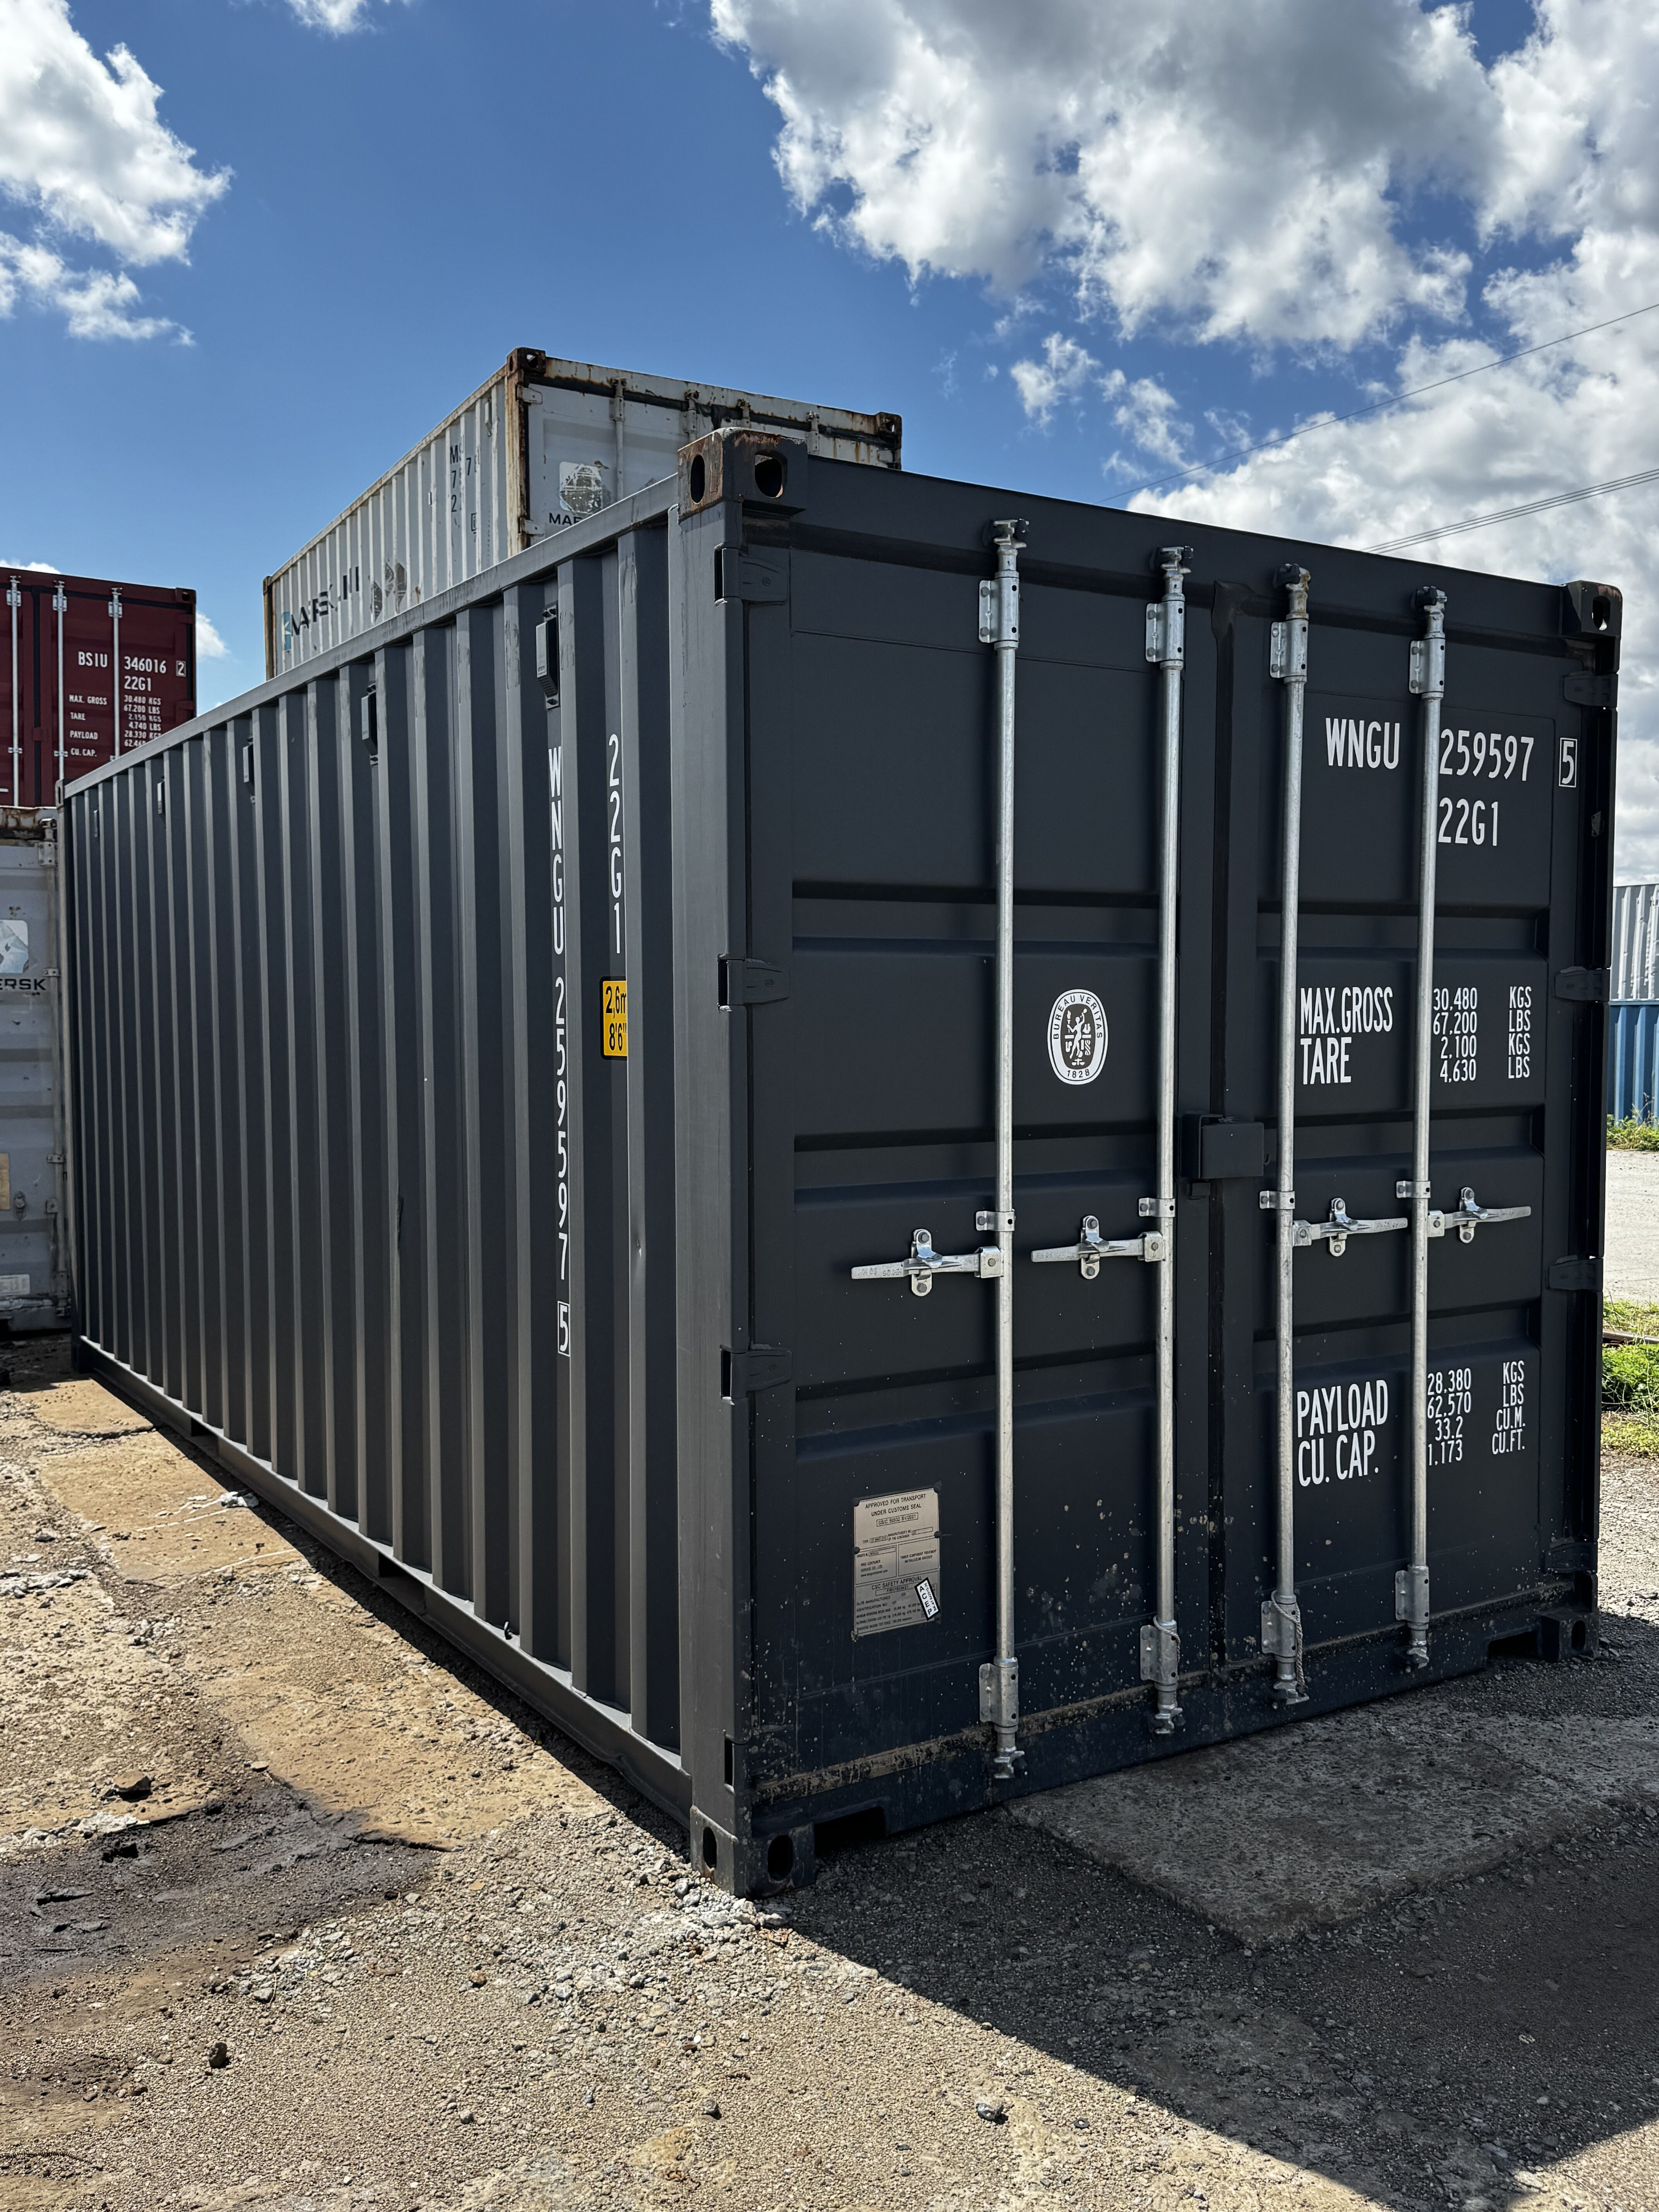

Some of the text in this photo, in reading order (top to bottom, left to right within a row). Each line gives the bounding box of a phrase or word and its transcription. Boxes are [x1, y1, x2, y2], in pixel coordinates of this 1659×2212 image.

[78, 651, 185, 676] BSIU 346016 2
[124, 675, 151, 691] 22G1
[69, 694, 107, 705] MAX. GROSS
[148, 706, 160, 714] LBS
[70, 712, 86, 720] TARE
[149, 723, 161, 731] LBS
[70, 730, 98, 740] PAYLOAD
[1326, 718, 1574, 784] WNGU 259597 5
[1438, 797, 1498, 846] 22G1
[609, 734, 622, 954] 22G1
[1433, 986, 1532, 1011] 30,480 KGS
[1053, 994, 1103, 1039] BUREAU VERITAS
[1433, 1010, 1531, 1035] 67,200 LBS
[548, 746, 568, 1352] WNGU 259597 5
[1441, 1033, 1530, 1059] 2,100 KGS
[1067, 1069, 1090, 1078] 1828
[1300, 1037, 1352, 1085] TARE
[1440, 1056, 1530, 1083] 4,630 LBS
[1427, 1360, 1525, 1395] 28,380 KGS
[1297, 1379, 1388, 1438] PAYLOAD
[1427, 1383, 1524, 1419] 62,570 LBS
[1435, 1416, 1463, 1441] 33.2
[1428, 1439, 1463, 1466] 1,173
[865, 1500, 889, 1509] APPROVED
[901, 1494, 926, 1503] TRANSPORT
[882, 1580, 899, 1588] SAFETY
[900, 1576, 922, 1584] APPROVAL
